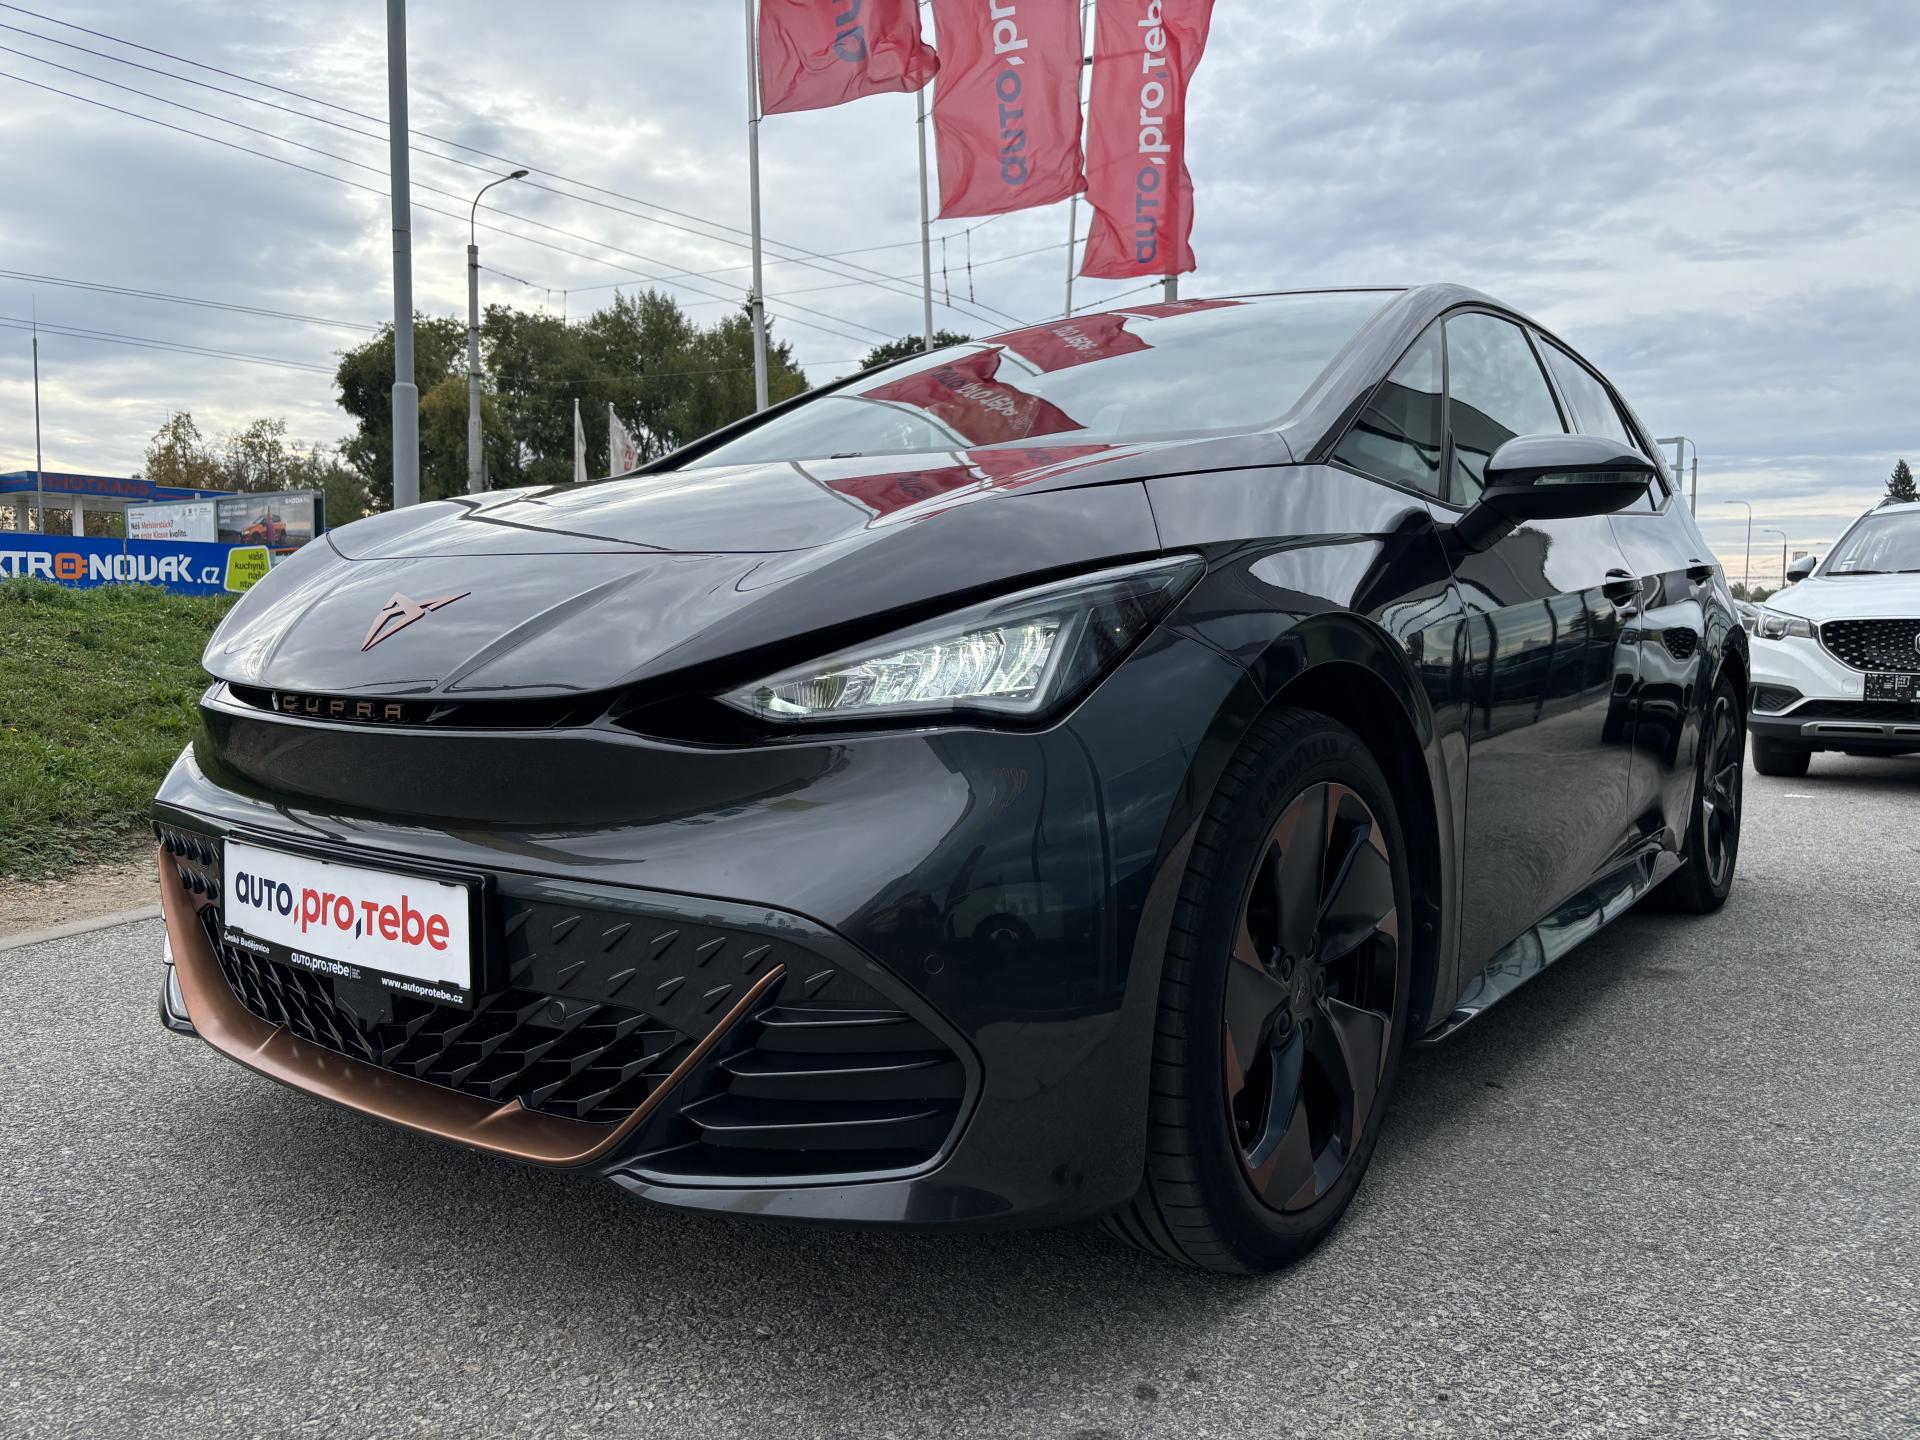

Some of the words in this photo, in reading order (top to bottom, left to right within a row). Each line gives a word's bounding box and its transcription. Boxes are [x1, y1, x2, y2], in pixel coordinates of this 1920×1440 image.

[283, 695, 403, 719] CUPRA
[240, 938, 270, 955] Budějovice
[381, 976, 464, 1004] www.autoprotebe.cz
